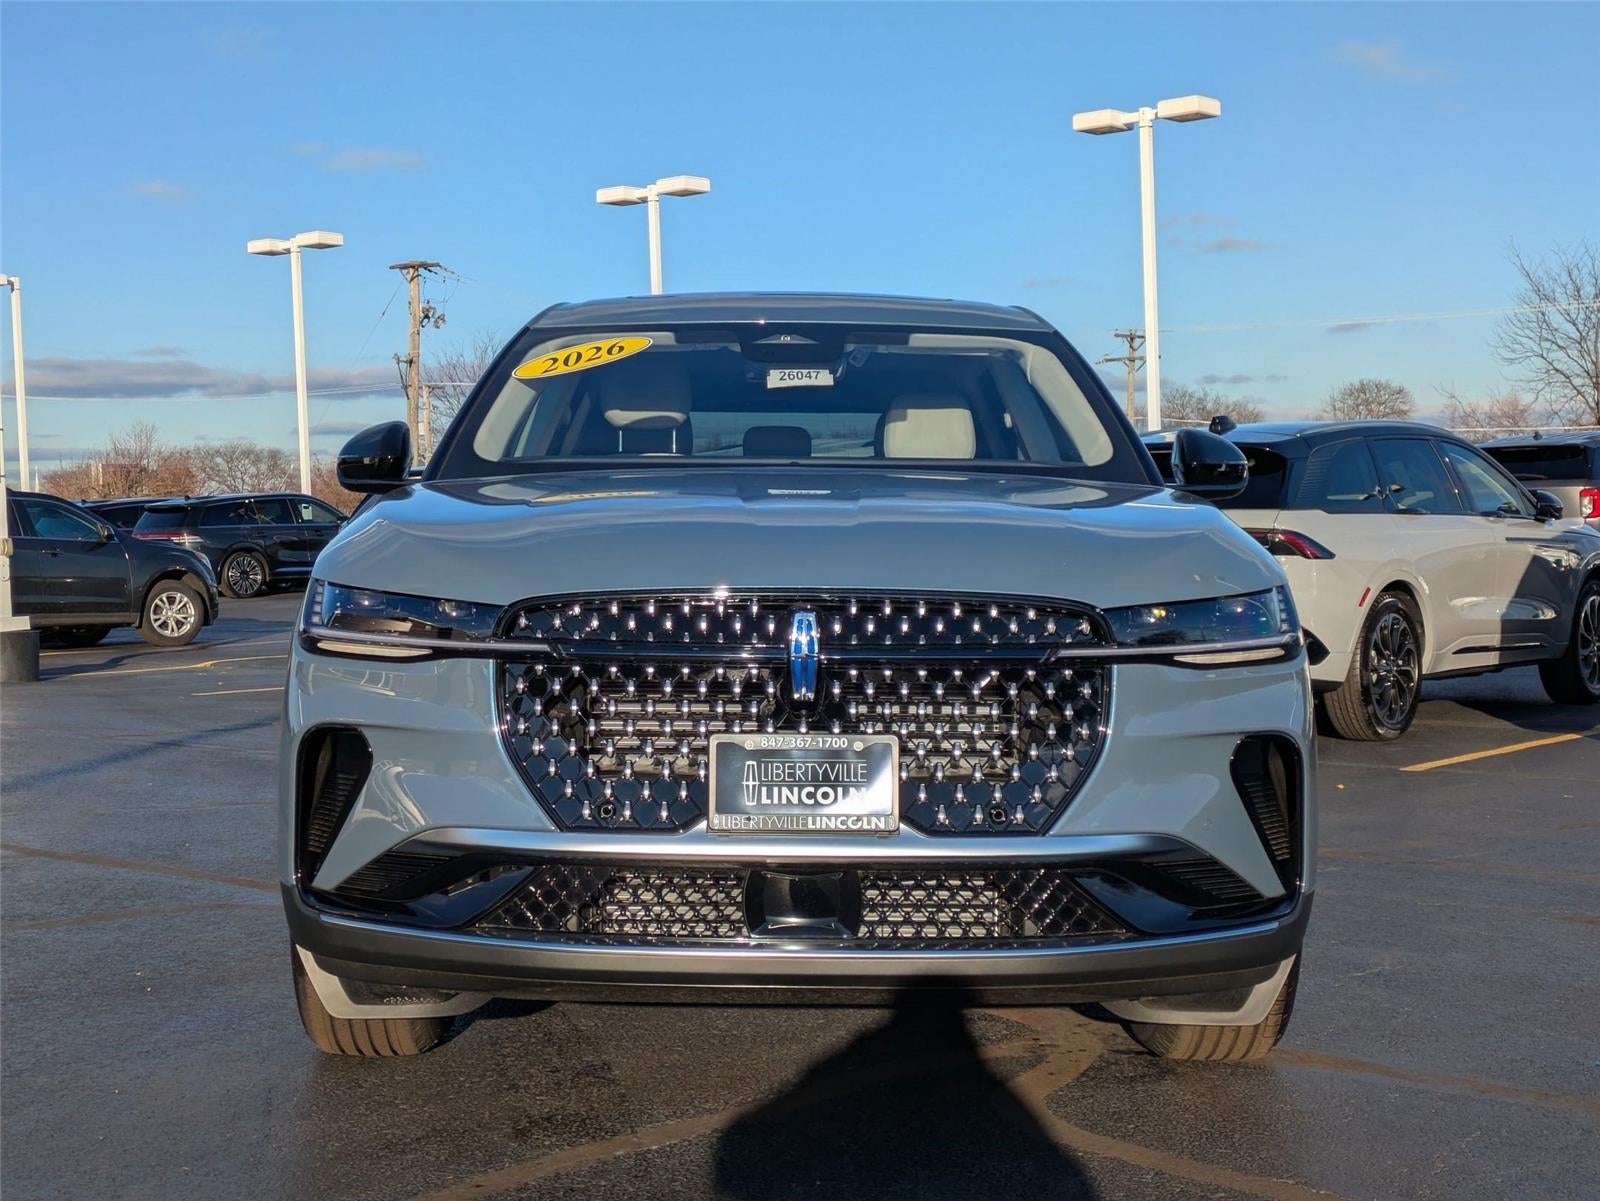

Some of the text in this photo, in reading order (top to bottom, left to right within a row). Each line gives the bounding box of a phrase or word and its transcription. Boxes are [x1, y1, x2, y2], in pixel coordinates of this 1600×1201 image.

[542, 339, 625, 374] 2026
[778, 370, 821, 381] 26047
[760, 737, 848, 748] 847-367-1700
[761, 763, 867, 782] LIBERTYVILLE
